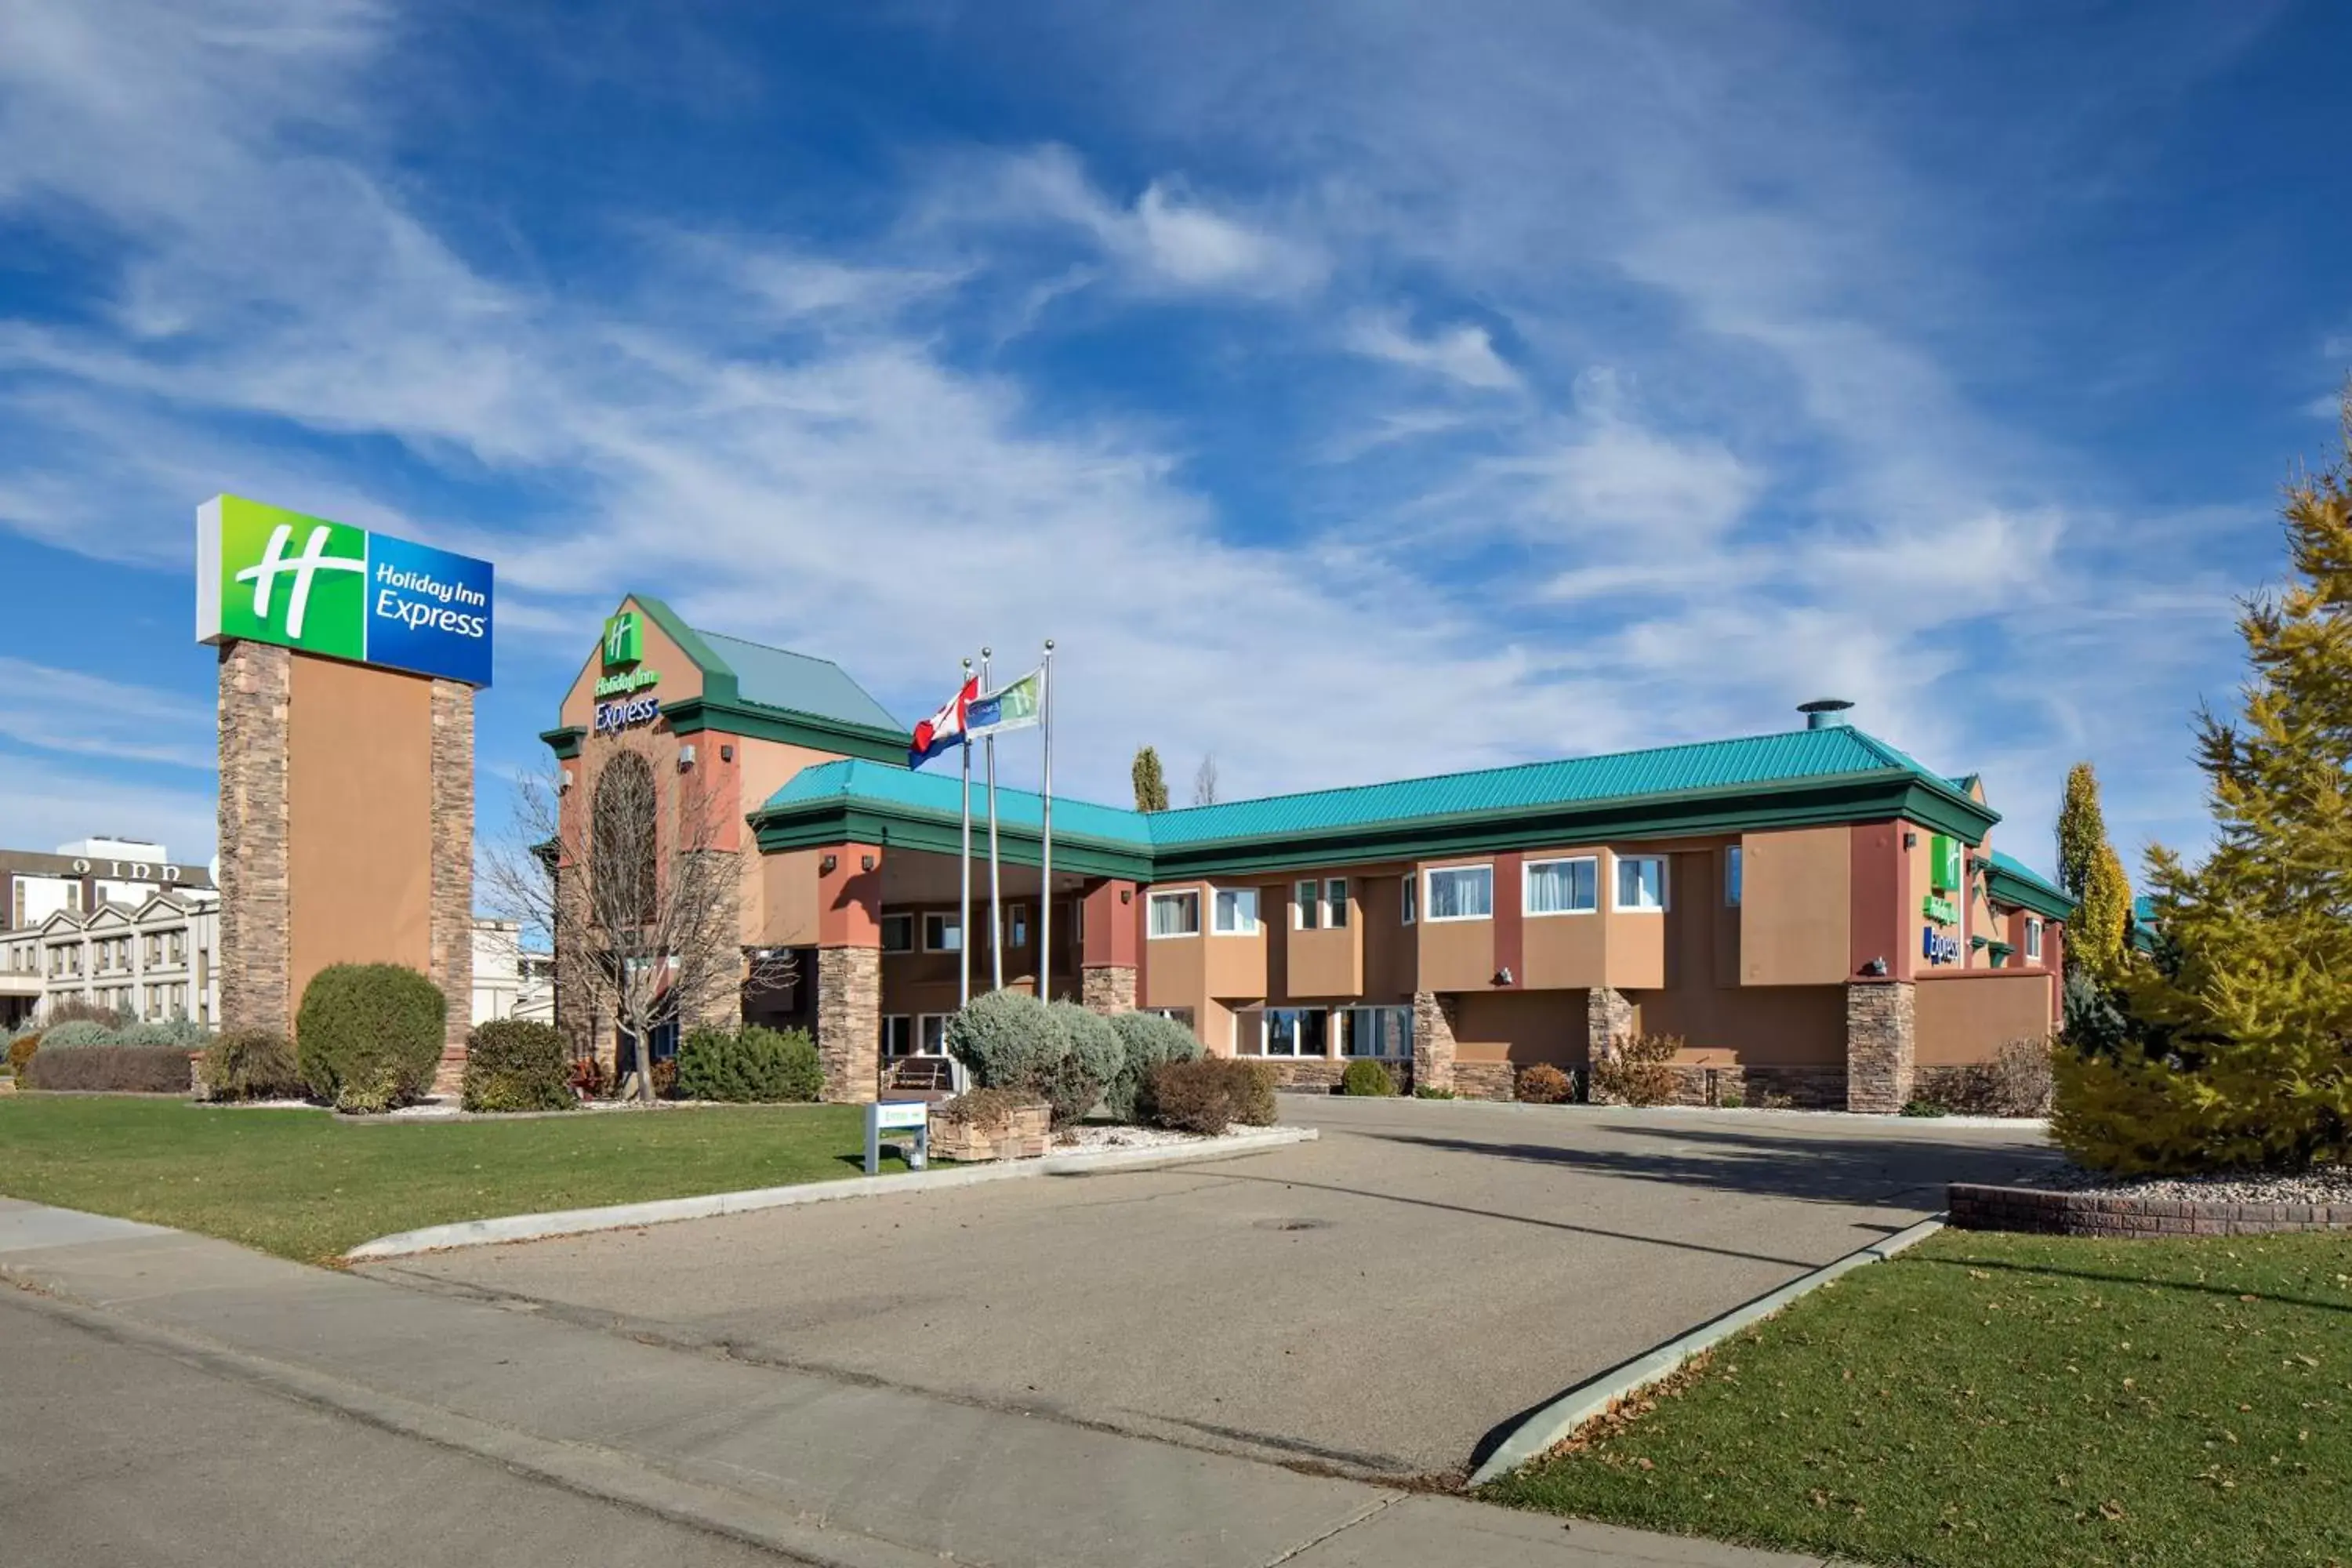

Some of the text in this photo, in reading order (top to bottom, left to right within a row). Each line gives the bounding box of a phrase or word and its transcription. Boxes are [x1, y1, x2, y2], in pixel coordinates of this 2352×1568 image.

[376, 562, 485, 608] Holiday Inn
[376, 589, 485, 638] Express
[596, 699, 654, 732] Express
